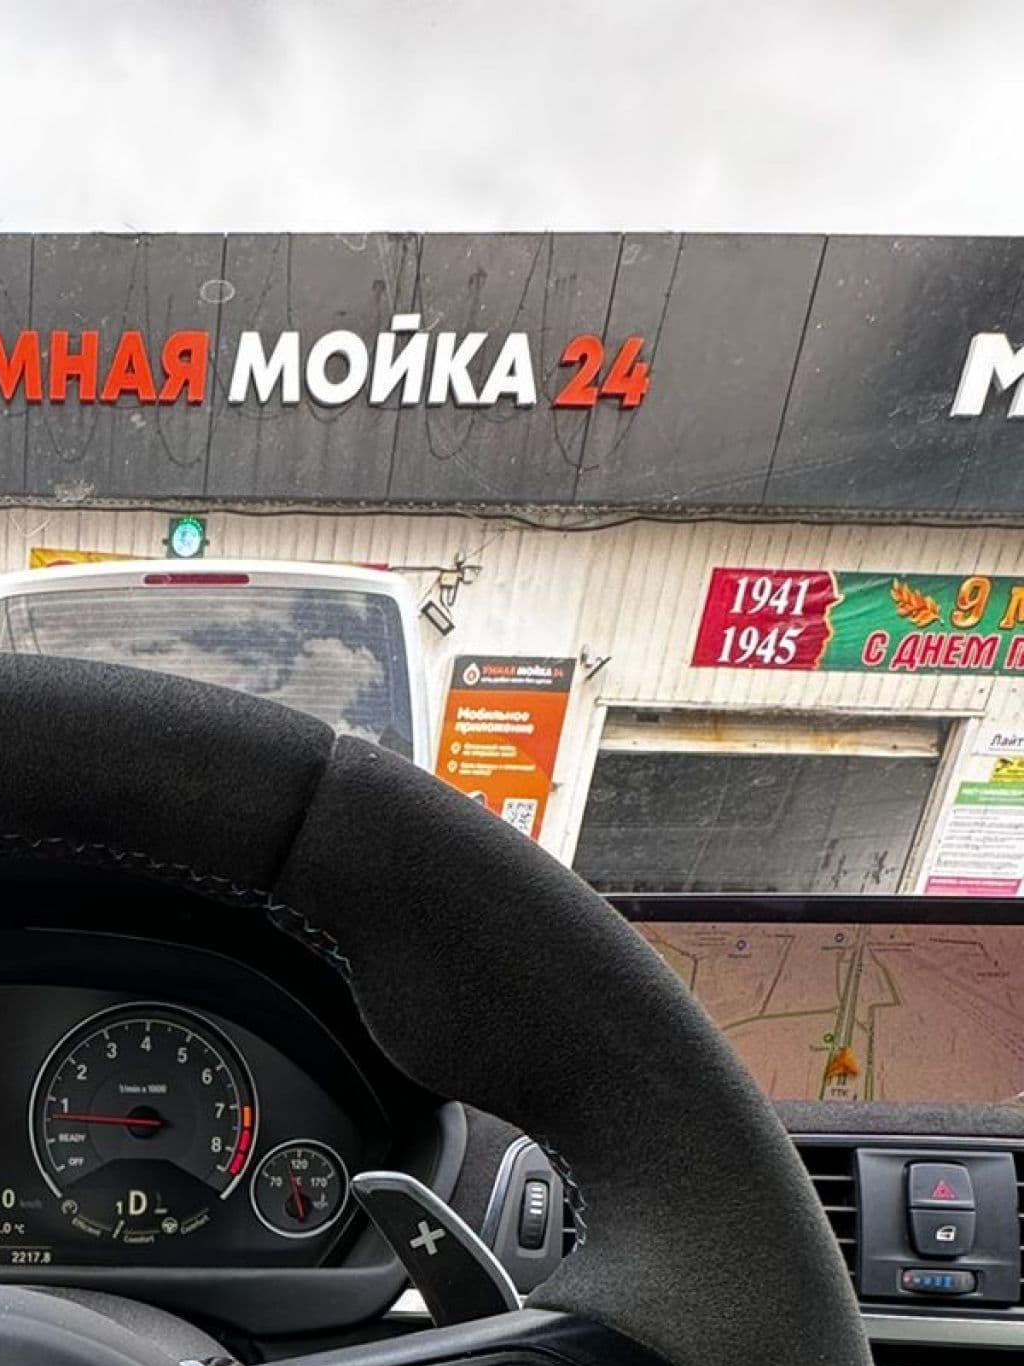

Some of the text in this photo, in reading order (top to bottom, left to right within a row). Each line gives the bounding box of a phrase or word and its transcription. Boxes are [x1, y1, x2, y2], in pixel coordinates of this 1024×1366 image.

[228, 314, 537, 408] МОЙКА
[551, 335, 651, 408] 24
[729, 576, 811, 616] 1941
[950, 575, 992, 630] 9
[718, 626, 804, 665] 1945
[862, 630, 888, 666] С
[889, 632, 1002, 672] ДНЕМ
[457, 707, 530, 721] Мобильное
[107, 1043, 117, 1058] 3
[141, 1036, 151, 1051] 4
[178, 1048, 188, 1063] 5
[77, 1065, 87, 1080] 2
[202, 1069, 212, 1084] 6
[61, 1098, 69, 1113] 1
[215, 1103, 225, 1118] 7
[59, 1133, 86, 1142] READY
[211, 1137, 222, 1152] 8
[68, 1157, 84, 1166] OFF
[291, 1159, 308, 1170] 120
[270, 1175, 282, 1187] 70
[311, 1177, 328, 1187] 170
[2, 1188, 15, 1208] 0
[129, 1190, 147, 1215] D
